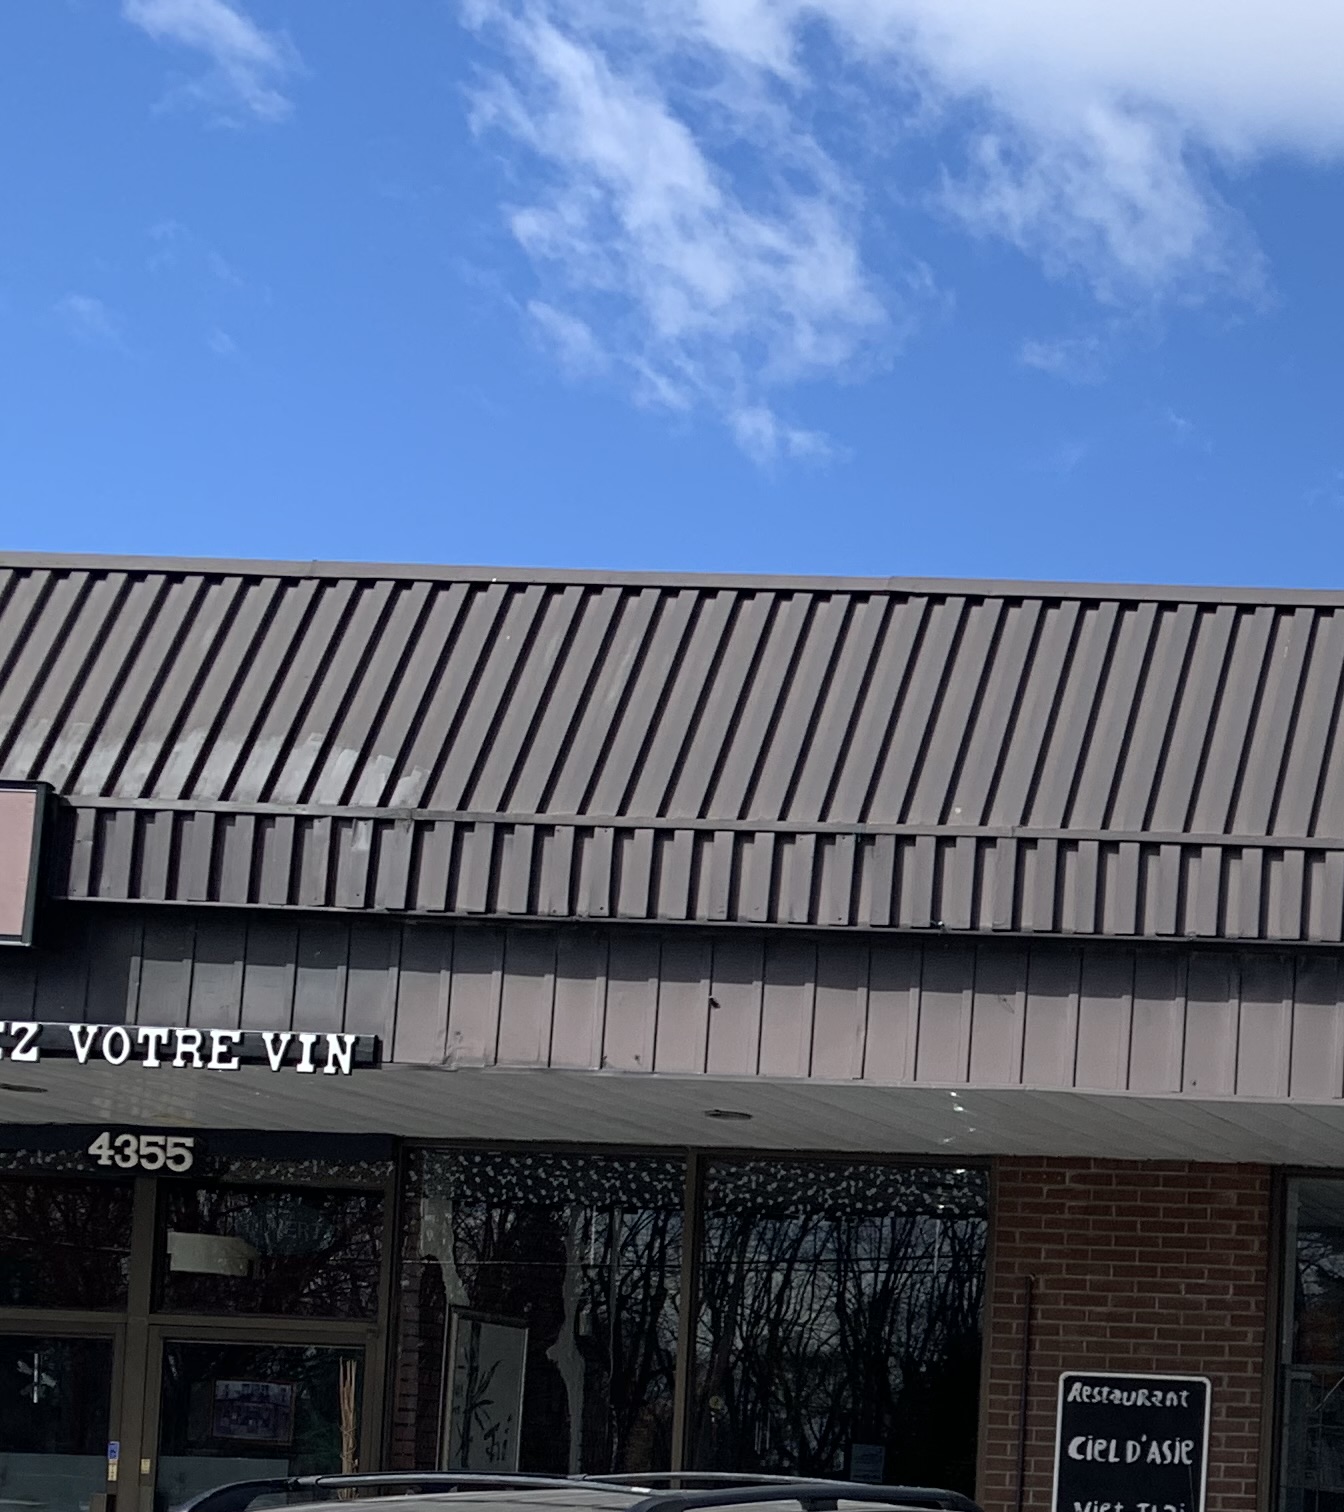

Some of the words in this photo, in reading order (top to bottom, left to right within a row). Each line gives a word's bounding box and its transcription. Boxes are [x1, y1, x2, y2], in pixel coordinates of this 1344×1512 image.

[69, 1026, 242, 1070] VOTRE
[262, 1033, 356, 1075] VIN
[88, 1132, 194, 1172] 4355
